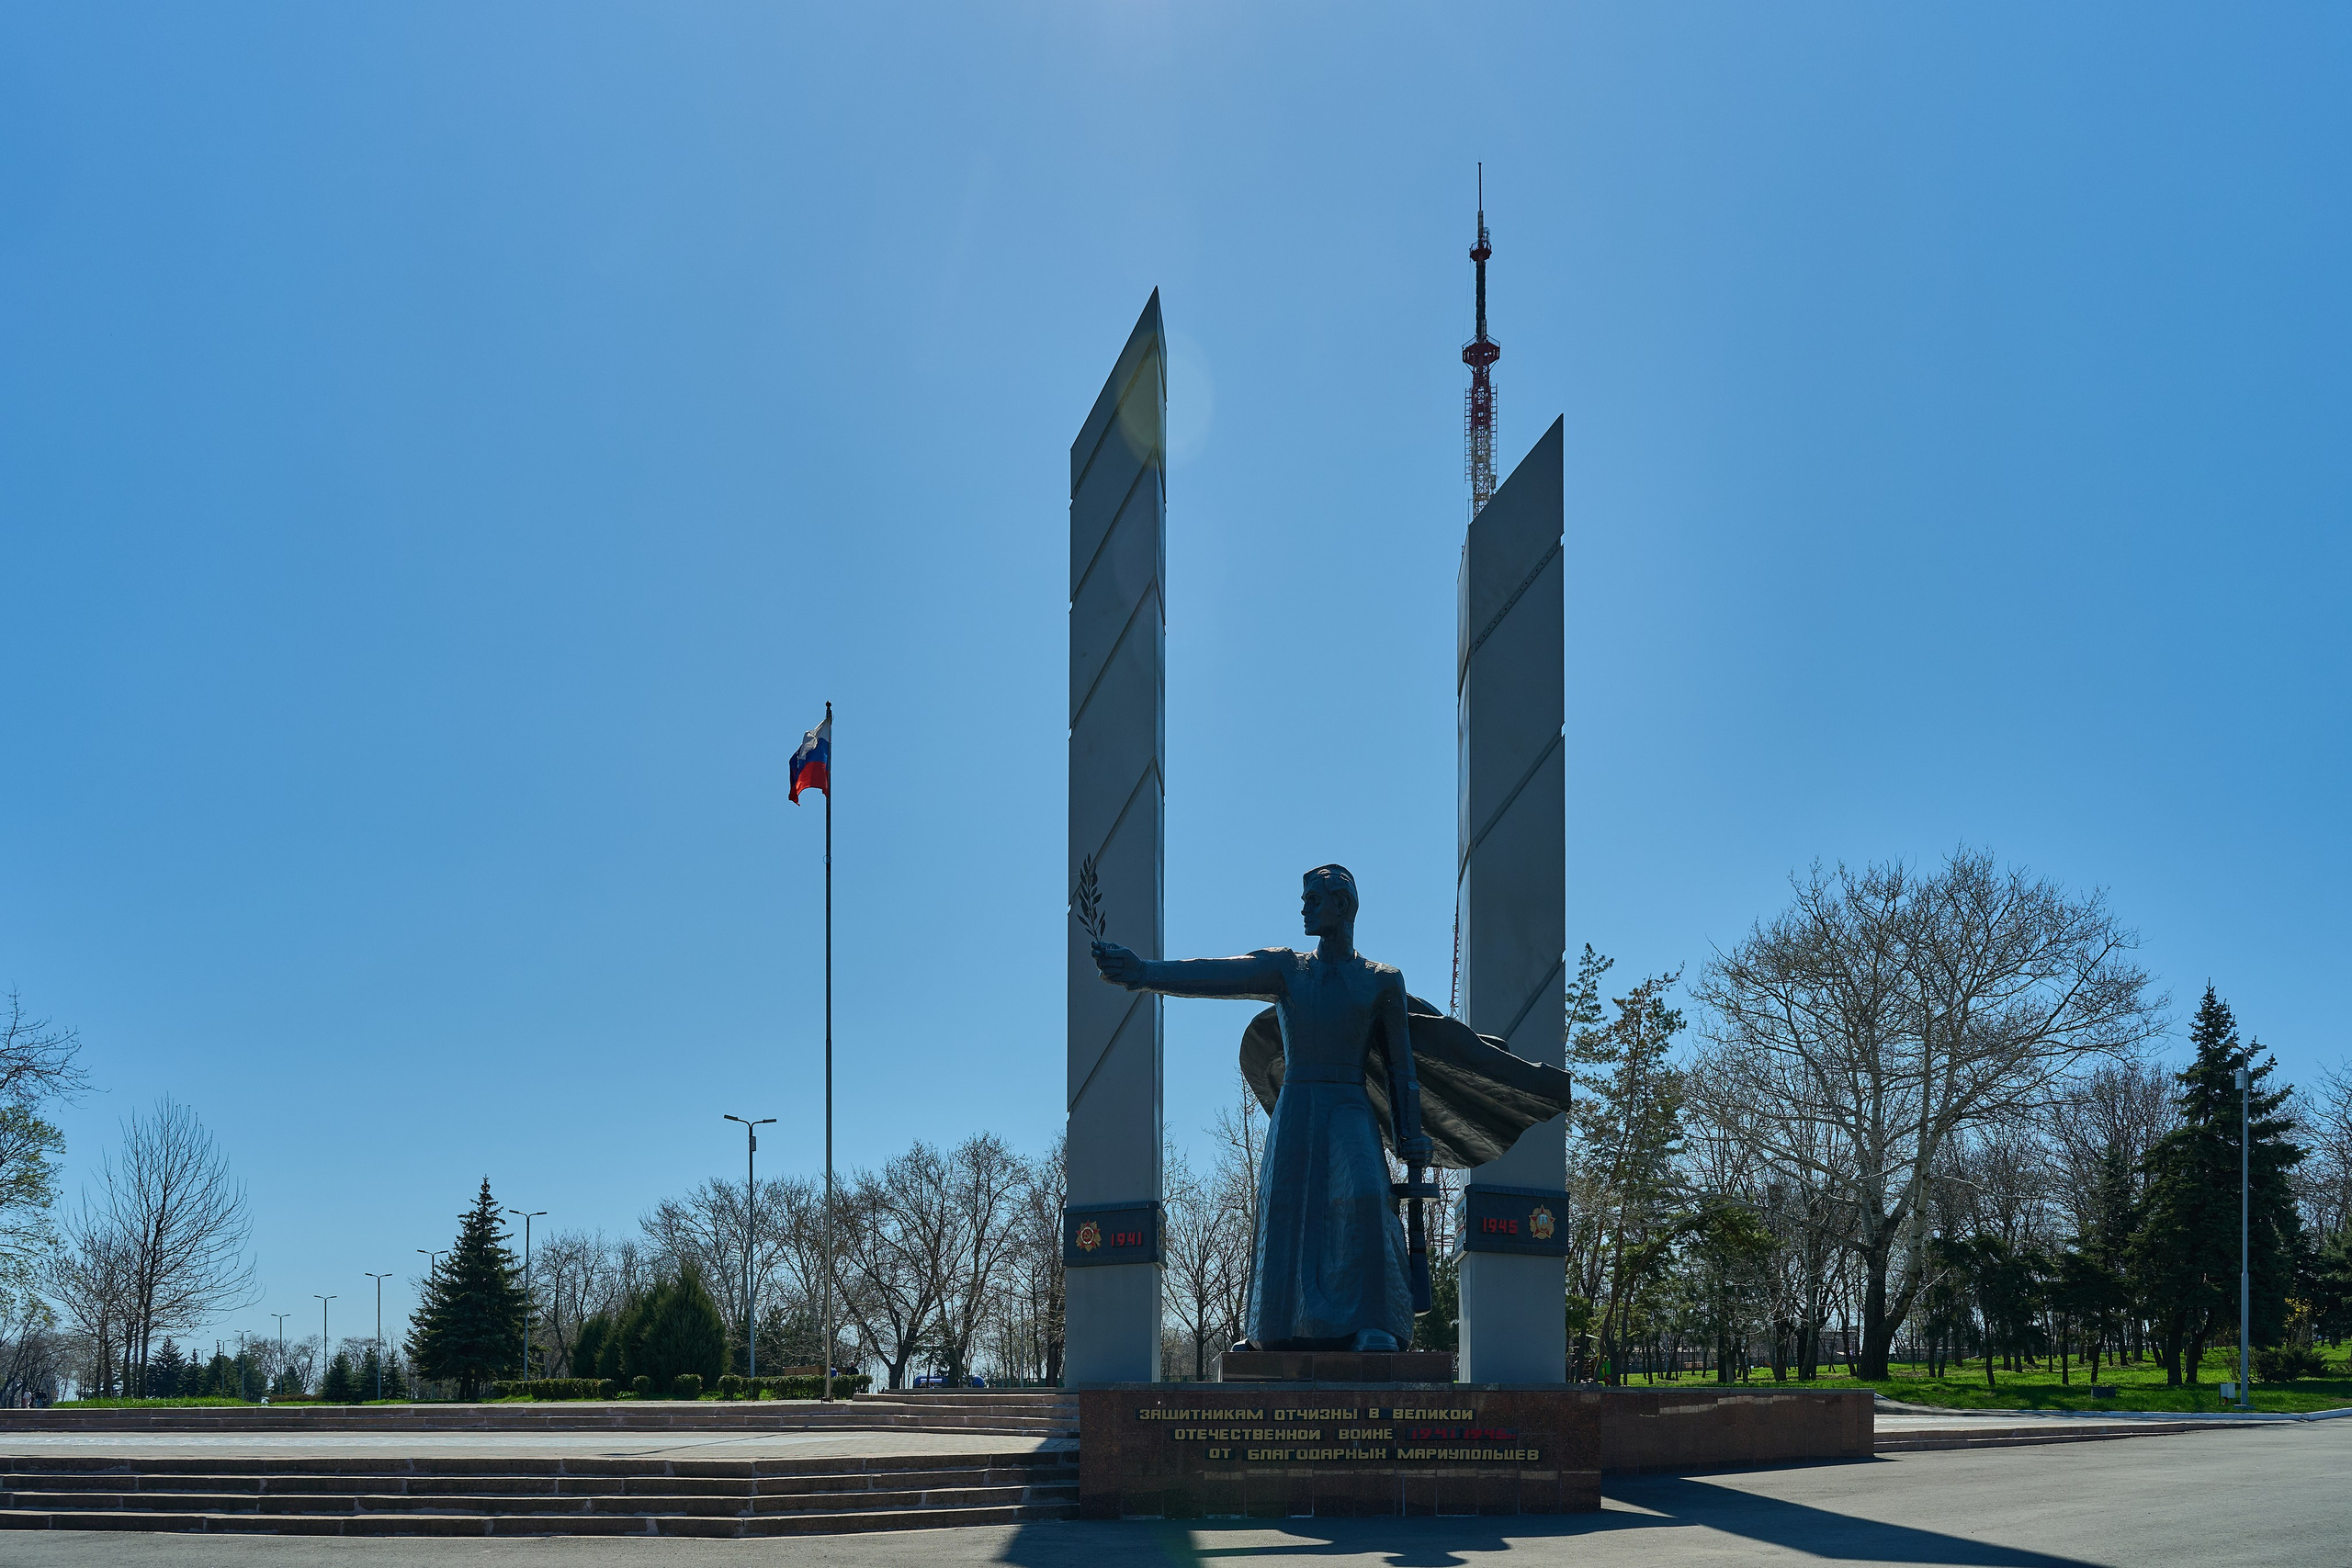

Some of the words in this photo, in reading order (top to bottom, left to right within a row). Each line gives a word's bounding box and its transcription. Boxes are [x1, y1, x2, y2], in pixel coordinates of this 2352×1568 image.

[1483, 1218, 1518, 1234] 1945
[1112, 1232, 1142, 1247] 1941
[1139, 1408, 1263, 1420] ЗАЩИТНИКАМ
[1274, 1408, 1358, 1420] ОТЧИЗНЫ
[1369, 1408, 1379, 1418] В
[1411, 1427, 1456, 1440] 1941
[1209, 1448, 1231, 1459] ОТ
[1248, 1448, 1386, 1461] БЛАГОДАРНЫХ
[1397, 1448, 1540, 1461] МАРИУПОЛЬЦЕВ
